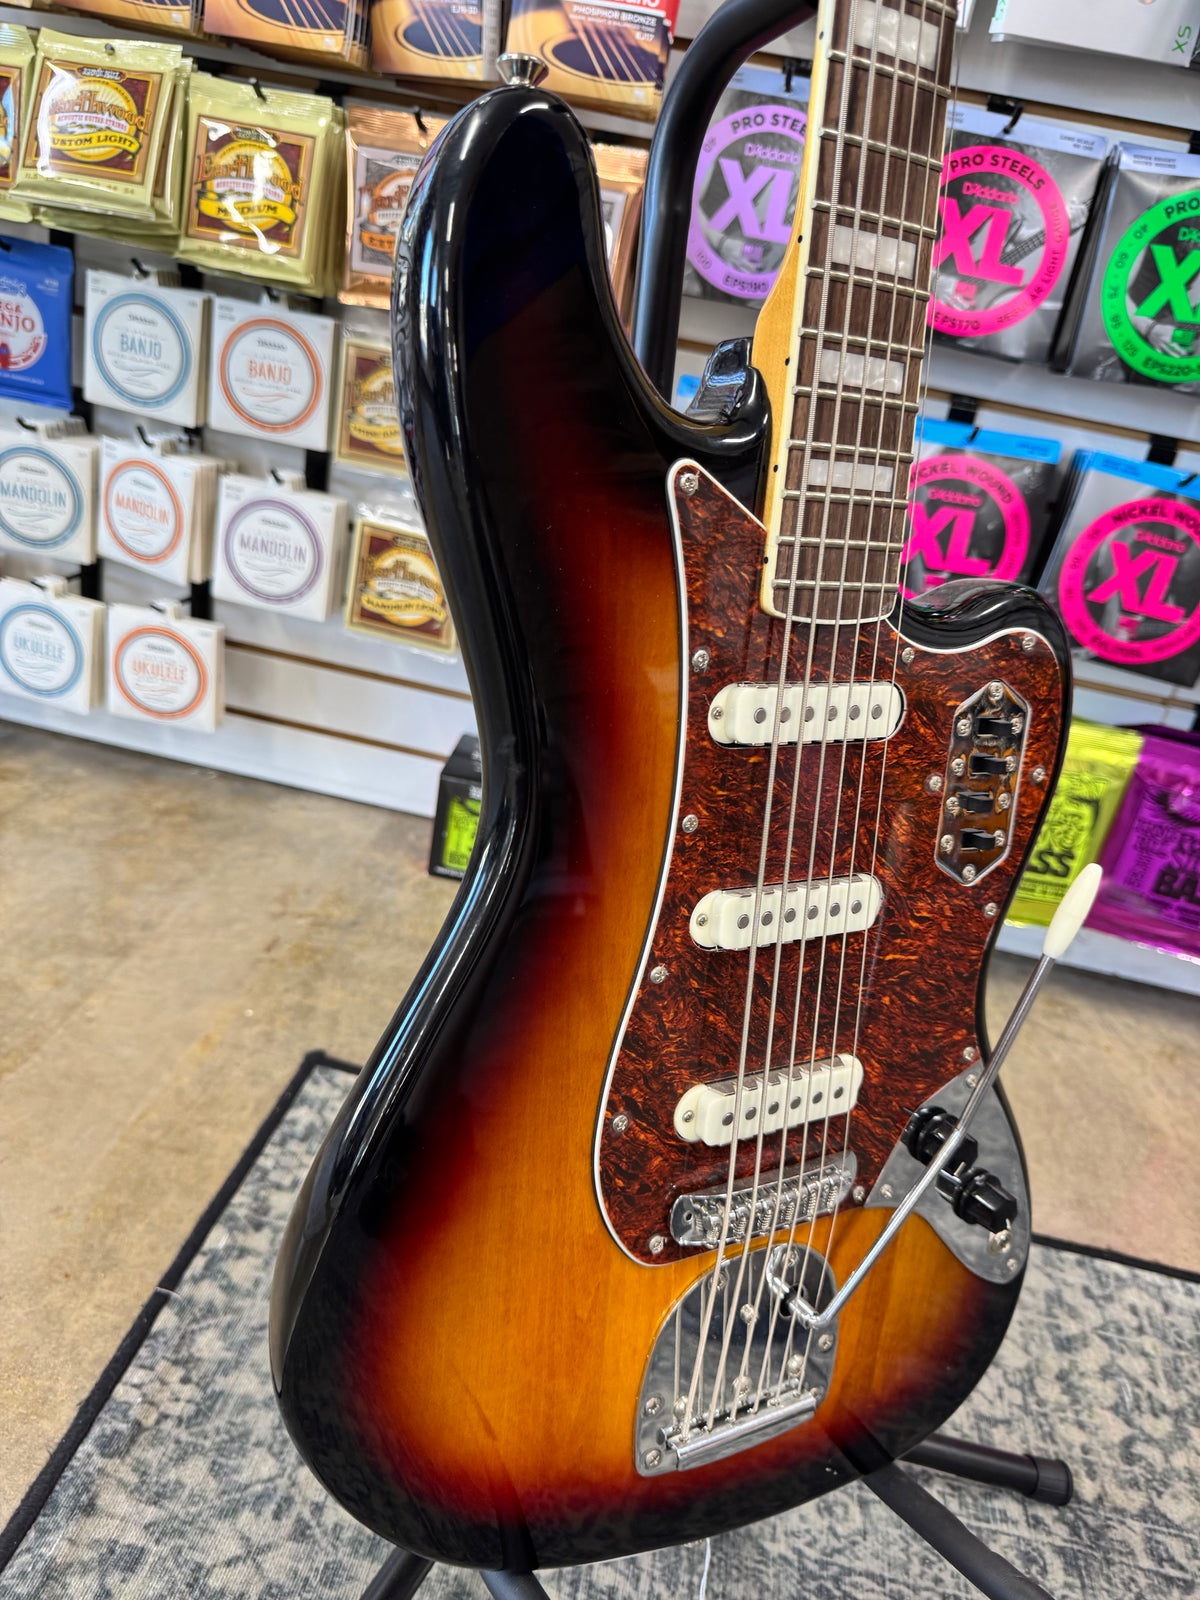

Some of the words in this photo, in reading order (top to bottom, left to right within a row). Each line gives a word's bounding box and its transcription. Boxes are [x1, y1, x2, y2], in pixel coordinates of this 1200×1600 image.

[573, 4, 620, 20] PHOSPHOR
[620, 11, 657, 27] BRONZE
[48, 89, 151, 130] arthwood
[730, 112, 766, 135] PRO
[770, 112, 807, 137] STEE
[52, 135, 93, 147] USTOM
[96, 133, 136, 148] LIGHT
[744, 142, 801, 166] D'Addario
[950, 152, 985, 174] PRO
[989, 153, 1046, 191] STEELS
[706, 157, 796, 245] XL
[962, 180, 1020, 205] D'Addario
[217, 204, 278, 217] MDIUM
[1164, 196, 1200, 219] PRO
[931, 195, 1026, 287] XL
[0, 313, 35, 333] NJO
[120, 333, 162, 360] BANJO
[248, 358, 292, 387] BANJO
[0, 480, 67, 508] MANDOLIN
[115, 490, 170, 526] MANDOLIN
[1111, 504, 1169, 526] NICKEL
[239, 532, 308, 564] MANDOLIN
[900, 502, 992, 578] XL
[1086, 540, 1187, 625] XL
[13, 631, 66, 662] UKULELE
[131, 658, 187, 684] UKULELE
